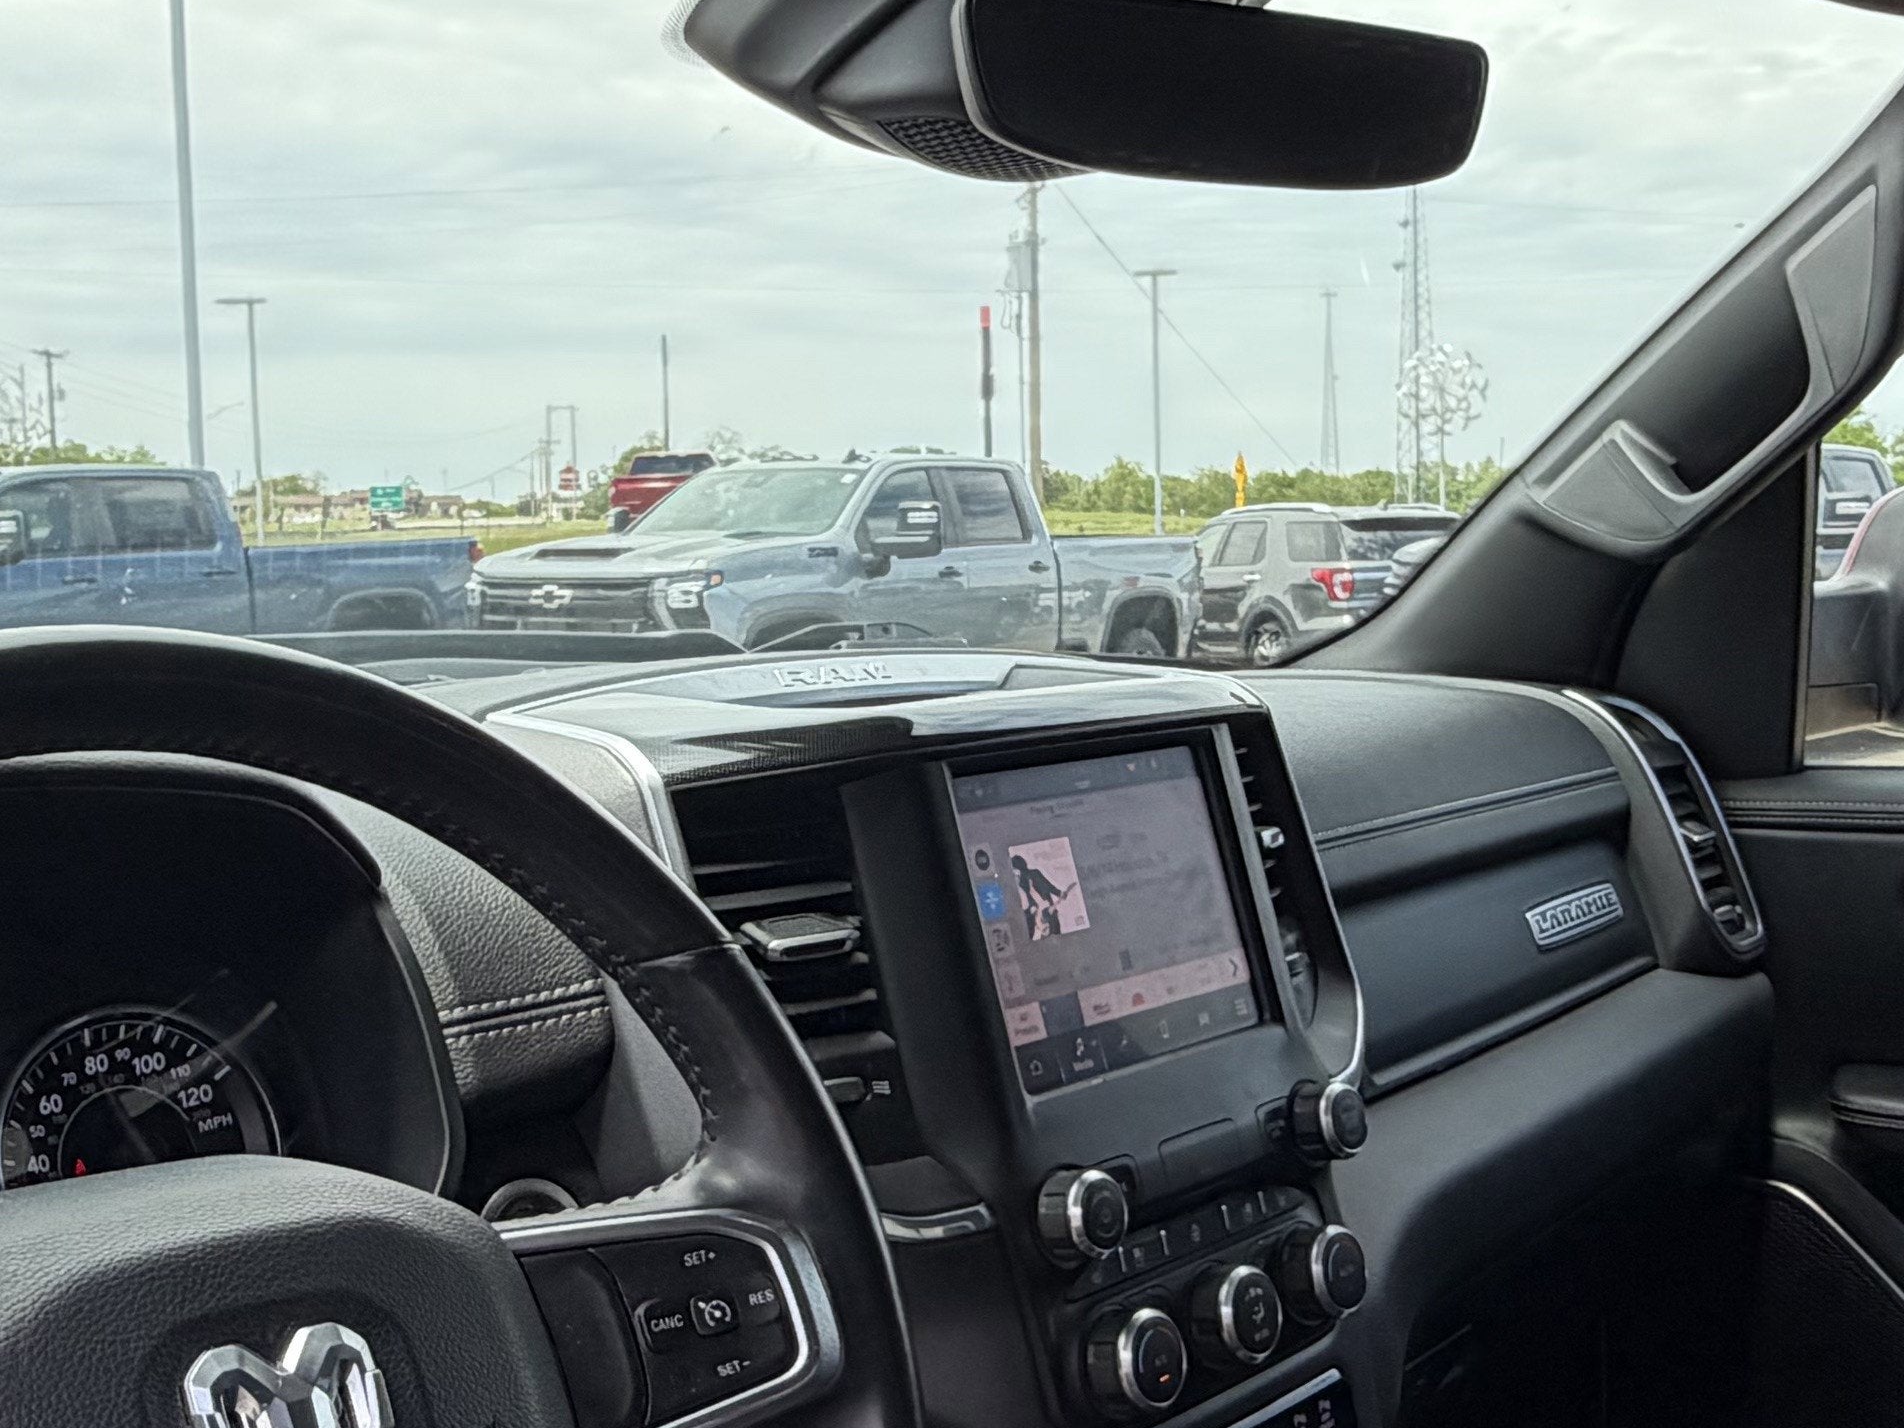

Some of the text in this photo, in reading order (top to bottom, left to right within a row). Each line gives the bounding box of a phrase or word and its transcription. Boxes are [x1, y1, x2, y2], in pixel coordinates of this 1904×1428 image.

[1535, 891, 1618, 935] LARAMIE
[84, 1053, 109, 1075] 80
[115, 1047, 132, 1061] 90
[131, 1052, 166, 1076] 100
[61, 1072, 78, 1086] 70
[38, 1093, 63, 1115] 60
[177, 1084, 214, 1109] 120
[198, 1112, 234, 1134] MPH
[27, 1154, 50, 1175] 40
[748, 1287, 776, 1307] RES
[650, 1312, 685, 1333] CANC
